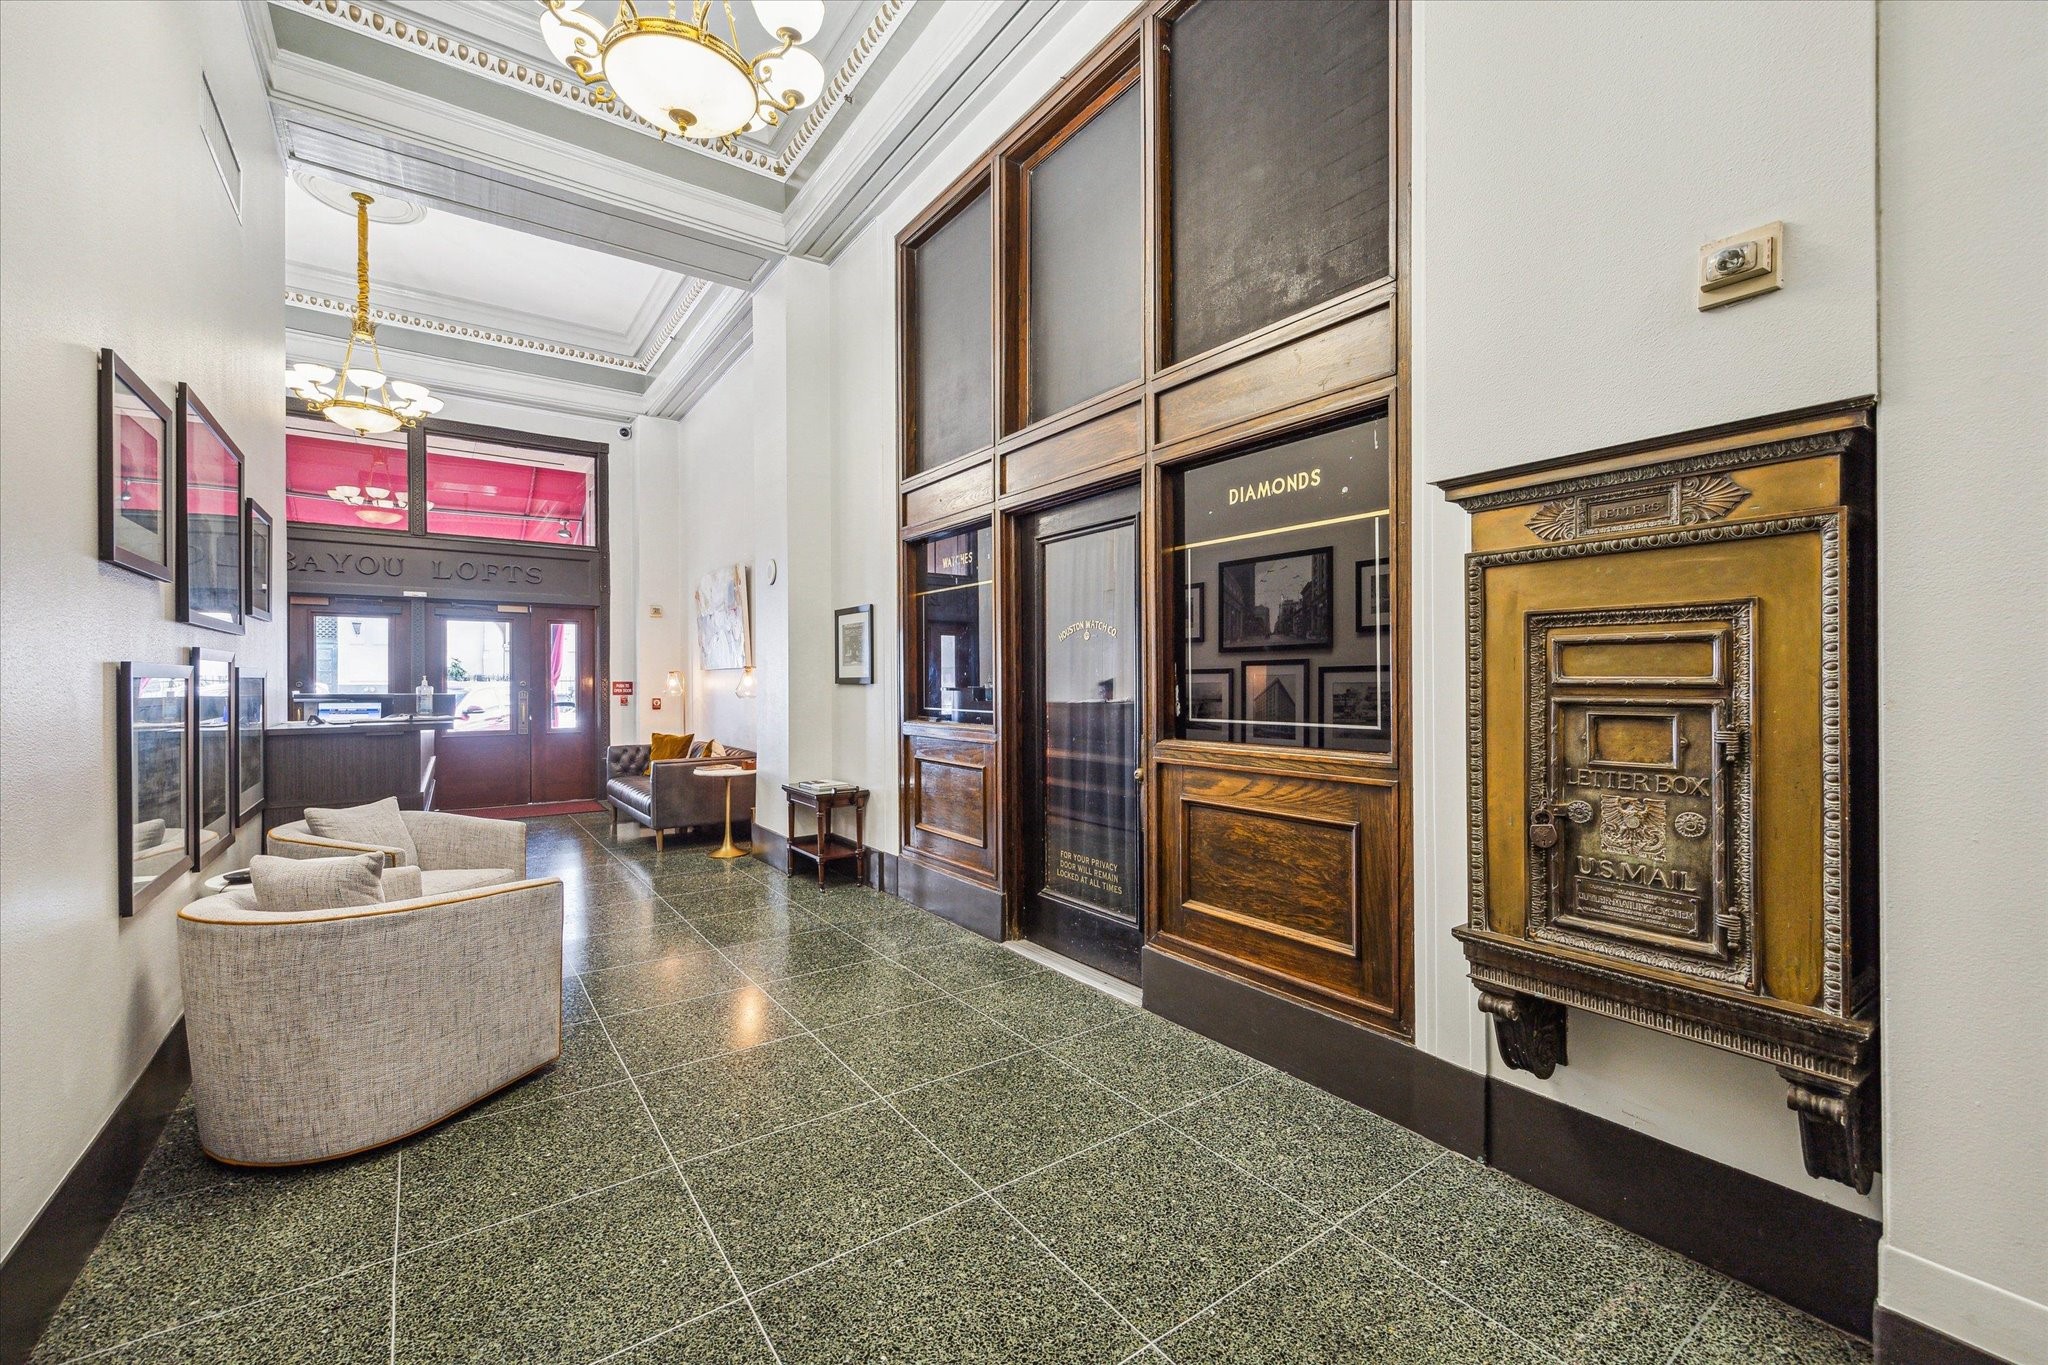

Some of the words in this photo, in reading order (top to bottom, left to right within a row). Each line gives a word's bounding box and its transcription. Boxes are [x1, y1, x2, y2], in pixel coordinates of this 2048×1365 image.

[1229, 468, 1321, 505] DIAMONDS
[1596, 502, 1661, 520] LETTERS
[432, 559, 544, 585] LOFTS
[942, 551, 973, 569] WATCHES
[1058, 620, 1085, 642] HOUSTON
[1085, 619, 1108, 633] WATCH
[1107, 625, 1118, 639] CO.
[1566, 767, 1652, 792] LETTER
[1655, 774, 1710, 797] BOX
[1060, 850, 1072, 860] FOR
[1073, 853, 1090, 865] YOUR
[1091, 858, 1118, 872] PRIVACY
[1060, 859, 1077, 871] DOOR
[1077, 864, 1093, 876] WILL
[1093, 869, 1119, 883] REMAIN
[1056, 868, 1080, 882] LOCKED
[1080, 875, 1088, 884] AT
[1089, 878, 1101, 889] ALL
[1102, 881, 1123, 895] TIMES
[1620, 862, 1697, 892] MAIL
